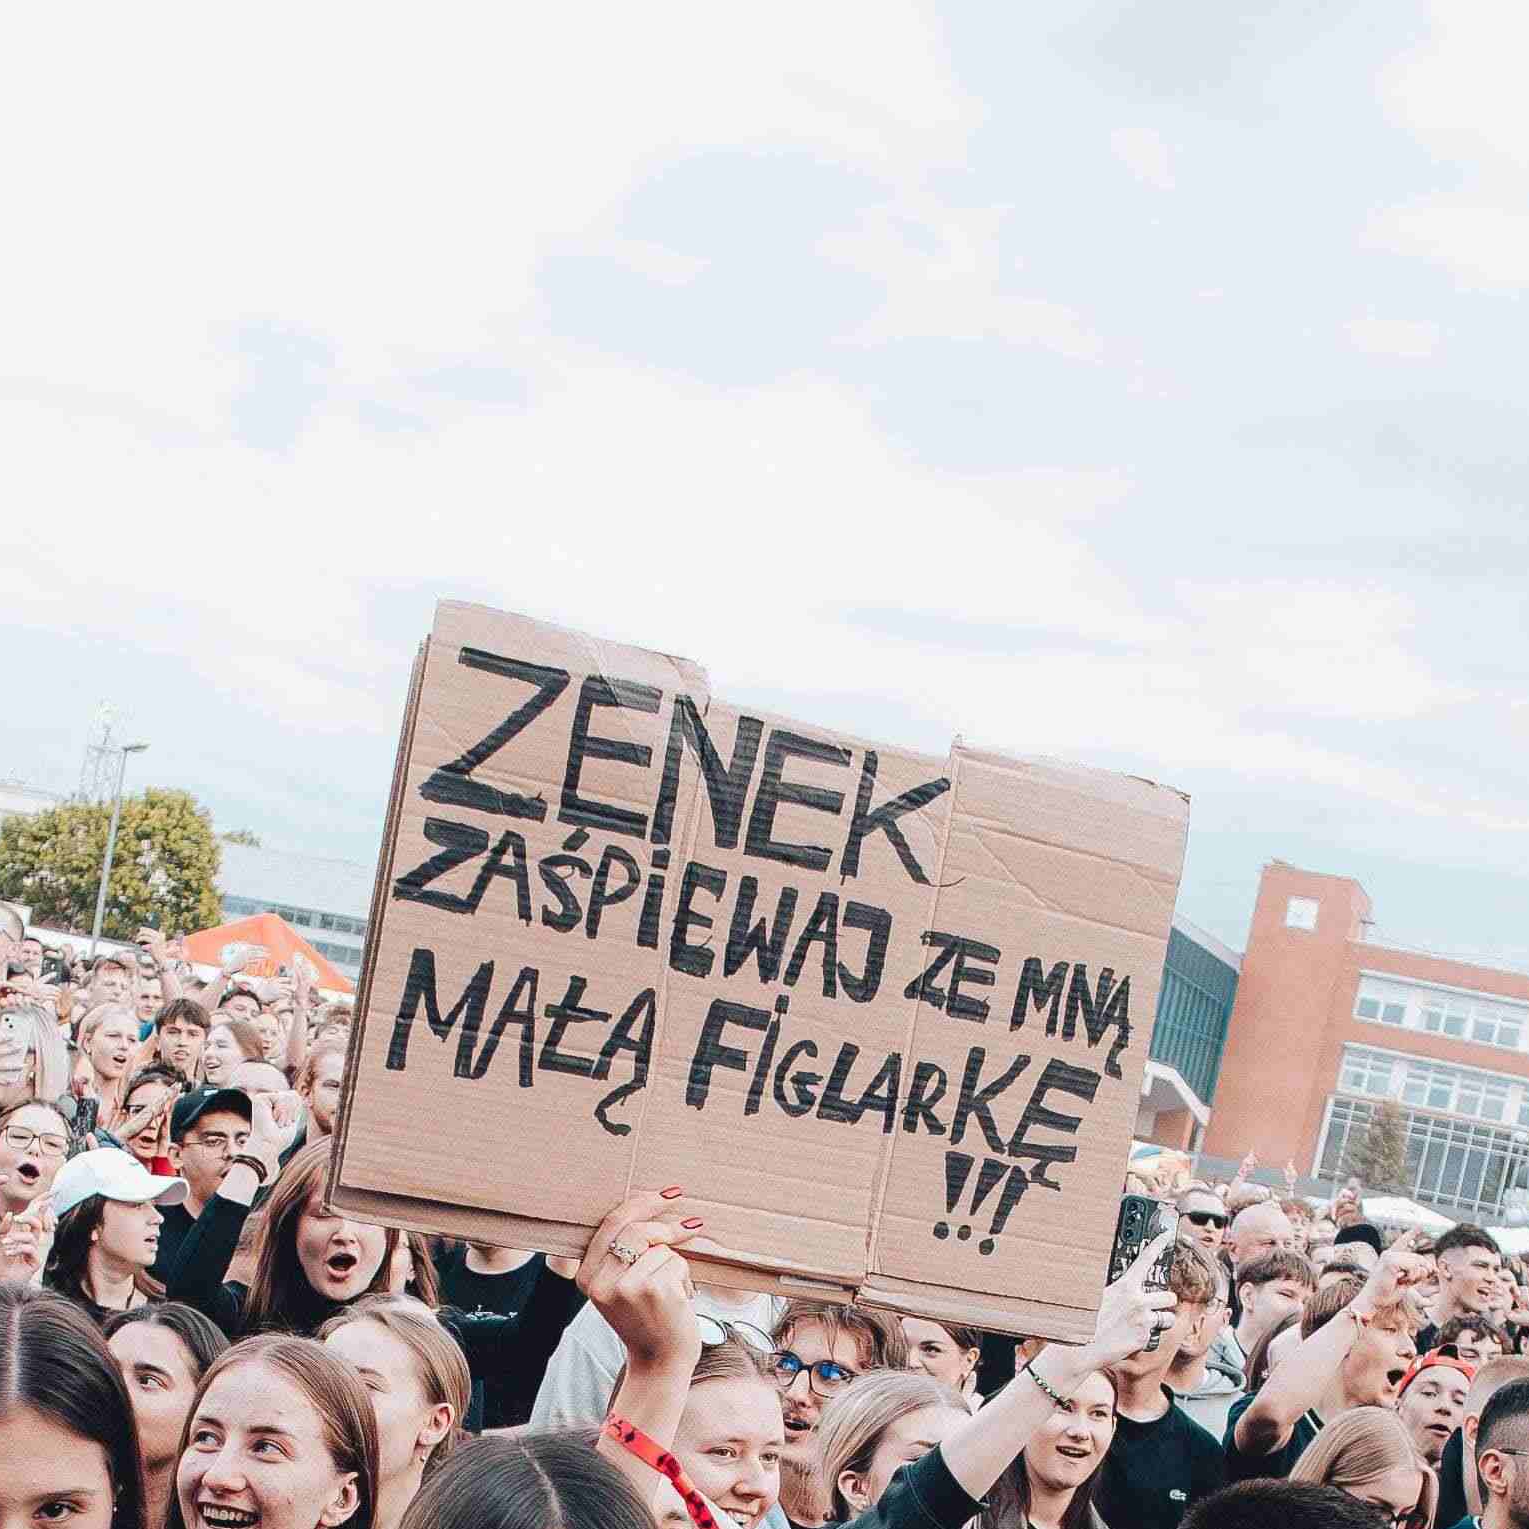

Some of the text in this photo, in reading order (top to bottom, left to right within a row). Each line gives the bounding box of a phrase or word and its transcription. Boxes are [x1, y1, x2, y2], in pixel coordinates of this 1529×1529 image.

[418, 646, 965, 888] ZENEK
[386, 947, 658, 1137] MAŁĄ
[904, 930, 1001, 1023] ZE
[1009, 955, 1134, 1079] MNĄ
